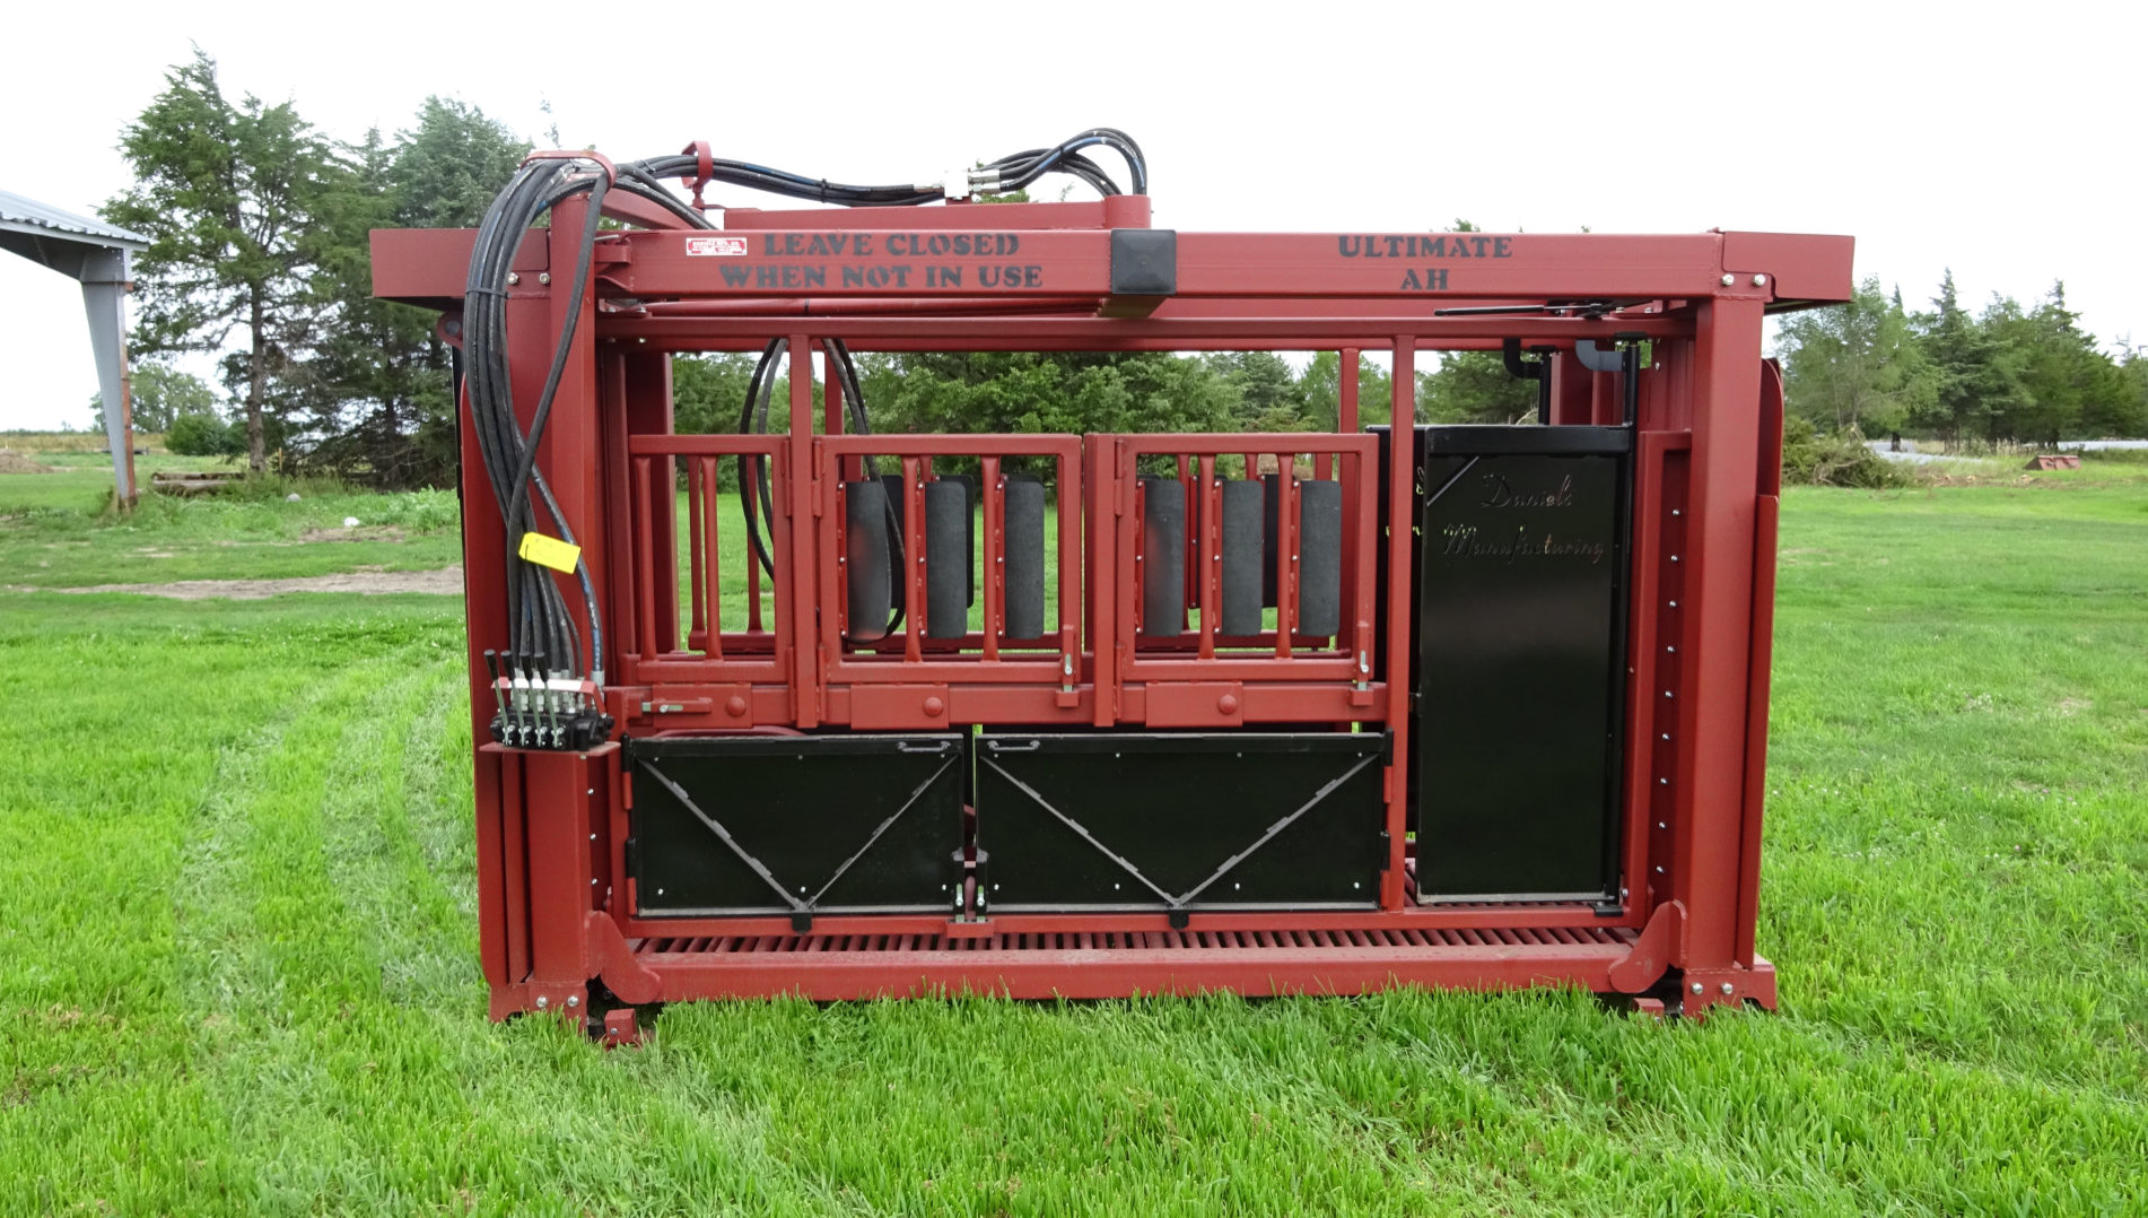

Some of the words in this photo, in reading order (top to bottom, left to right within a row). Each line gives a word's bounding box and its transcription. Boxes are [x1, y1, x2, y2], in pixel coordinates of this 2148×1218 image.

[764, 233, 872, 256] LEAVE
[886, 233, 1019, 256] CLOSED
[1338, 235, 1512, 258] ULTIMATE
[720, 265, 825, 288] WHEN
[842, 266, 911, 288] NOT
[925, 266, 962, 288] IN
[978, 266, 1043, 288] USE
[1401, 268, 1449, 290] AH
